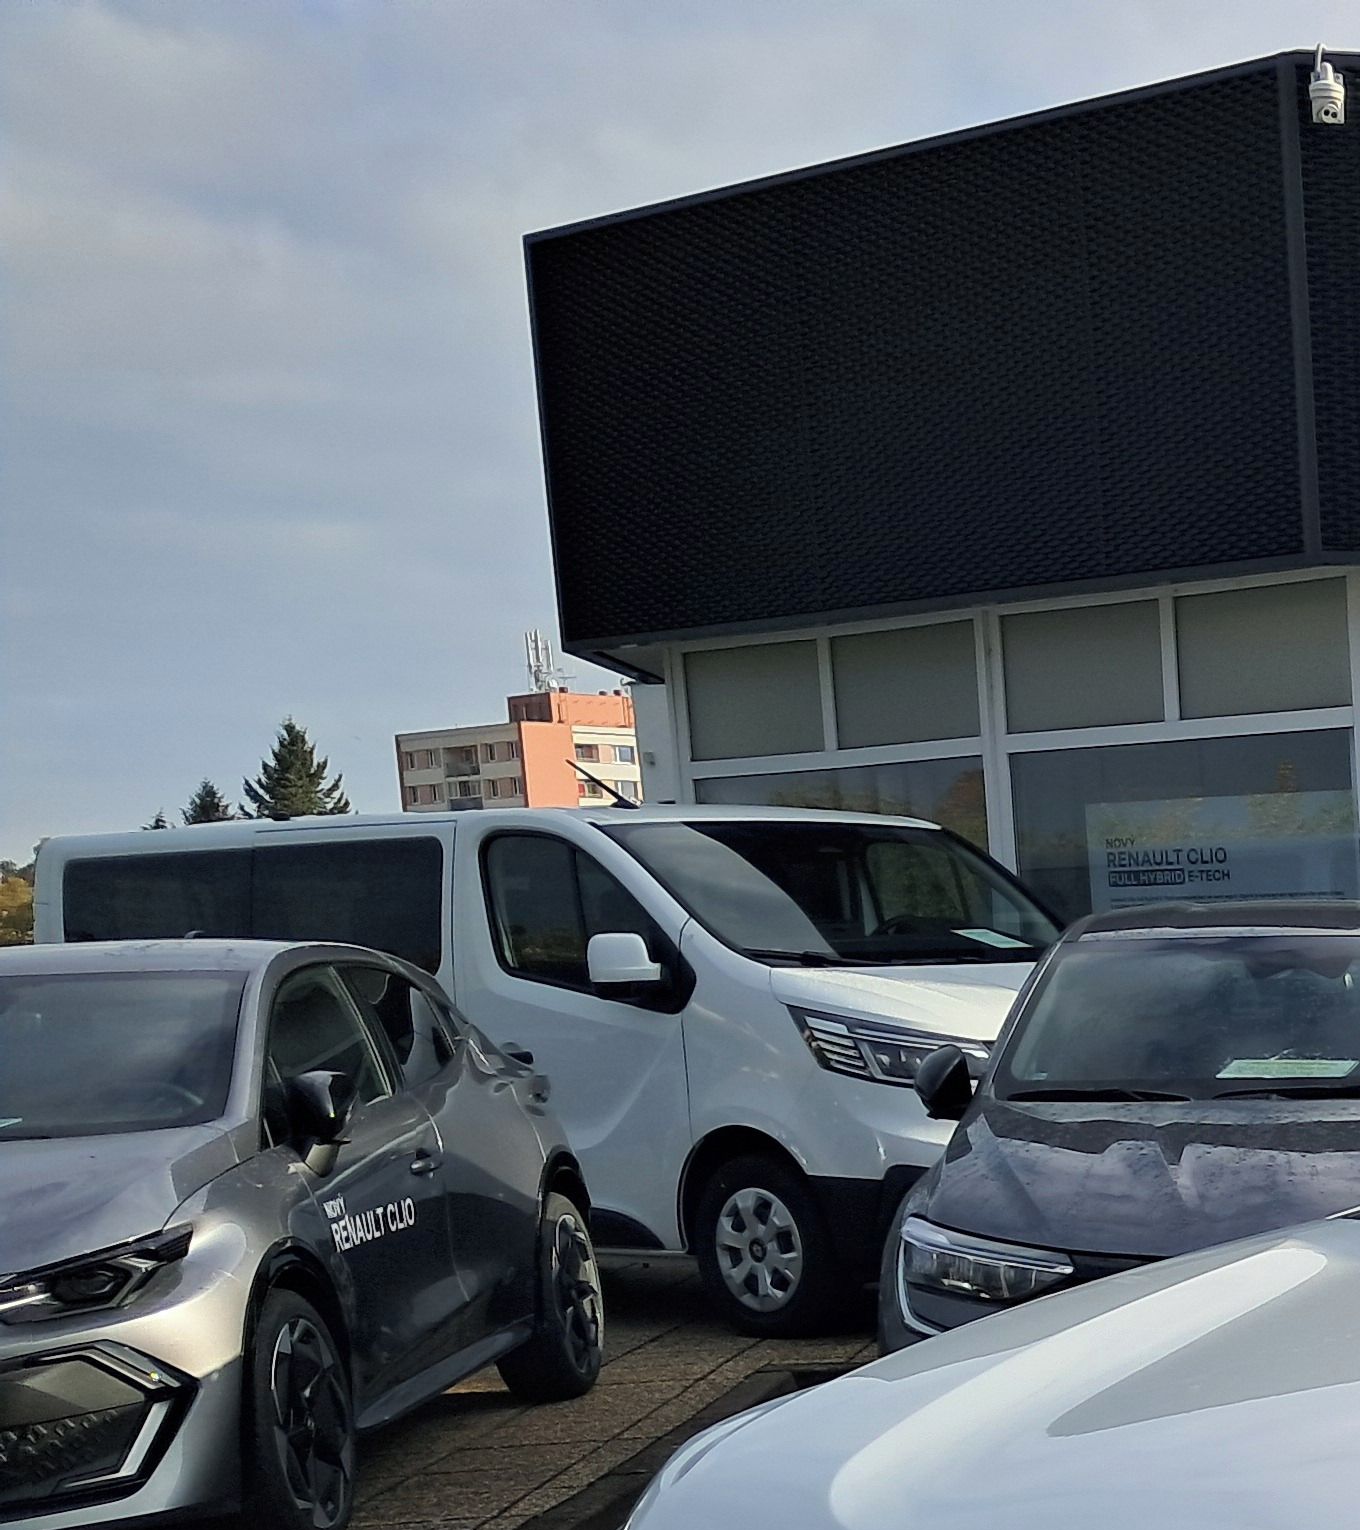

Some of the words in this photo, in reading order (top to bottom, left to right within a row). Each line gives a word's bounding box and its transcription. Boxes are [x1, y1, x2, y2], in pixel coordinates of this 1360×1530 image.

[1107, 849, 1183, 868] RENAULT
[1187, 847, 1228, 865] CLIO
[1110, 871, 1136, 886] FULL
[1140, 870, 1184, 885] HYBRID
[1188, 869, 1231, 882] E-TECH
[331, 1206, 385, 1253] RENAULT
[387, 1197, 415, 1232] CLIO
